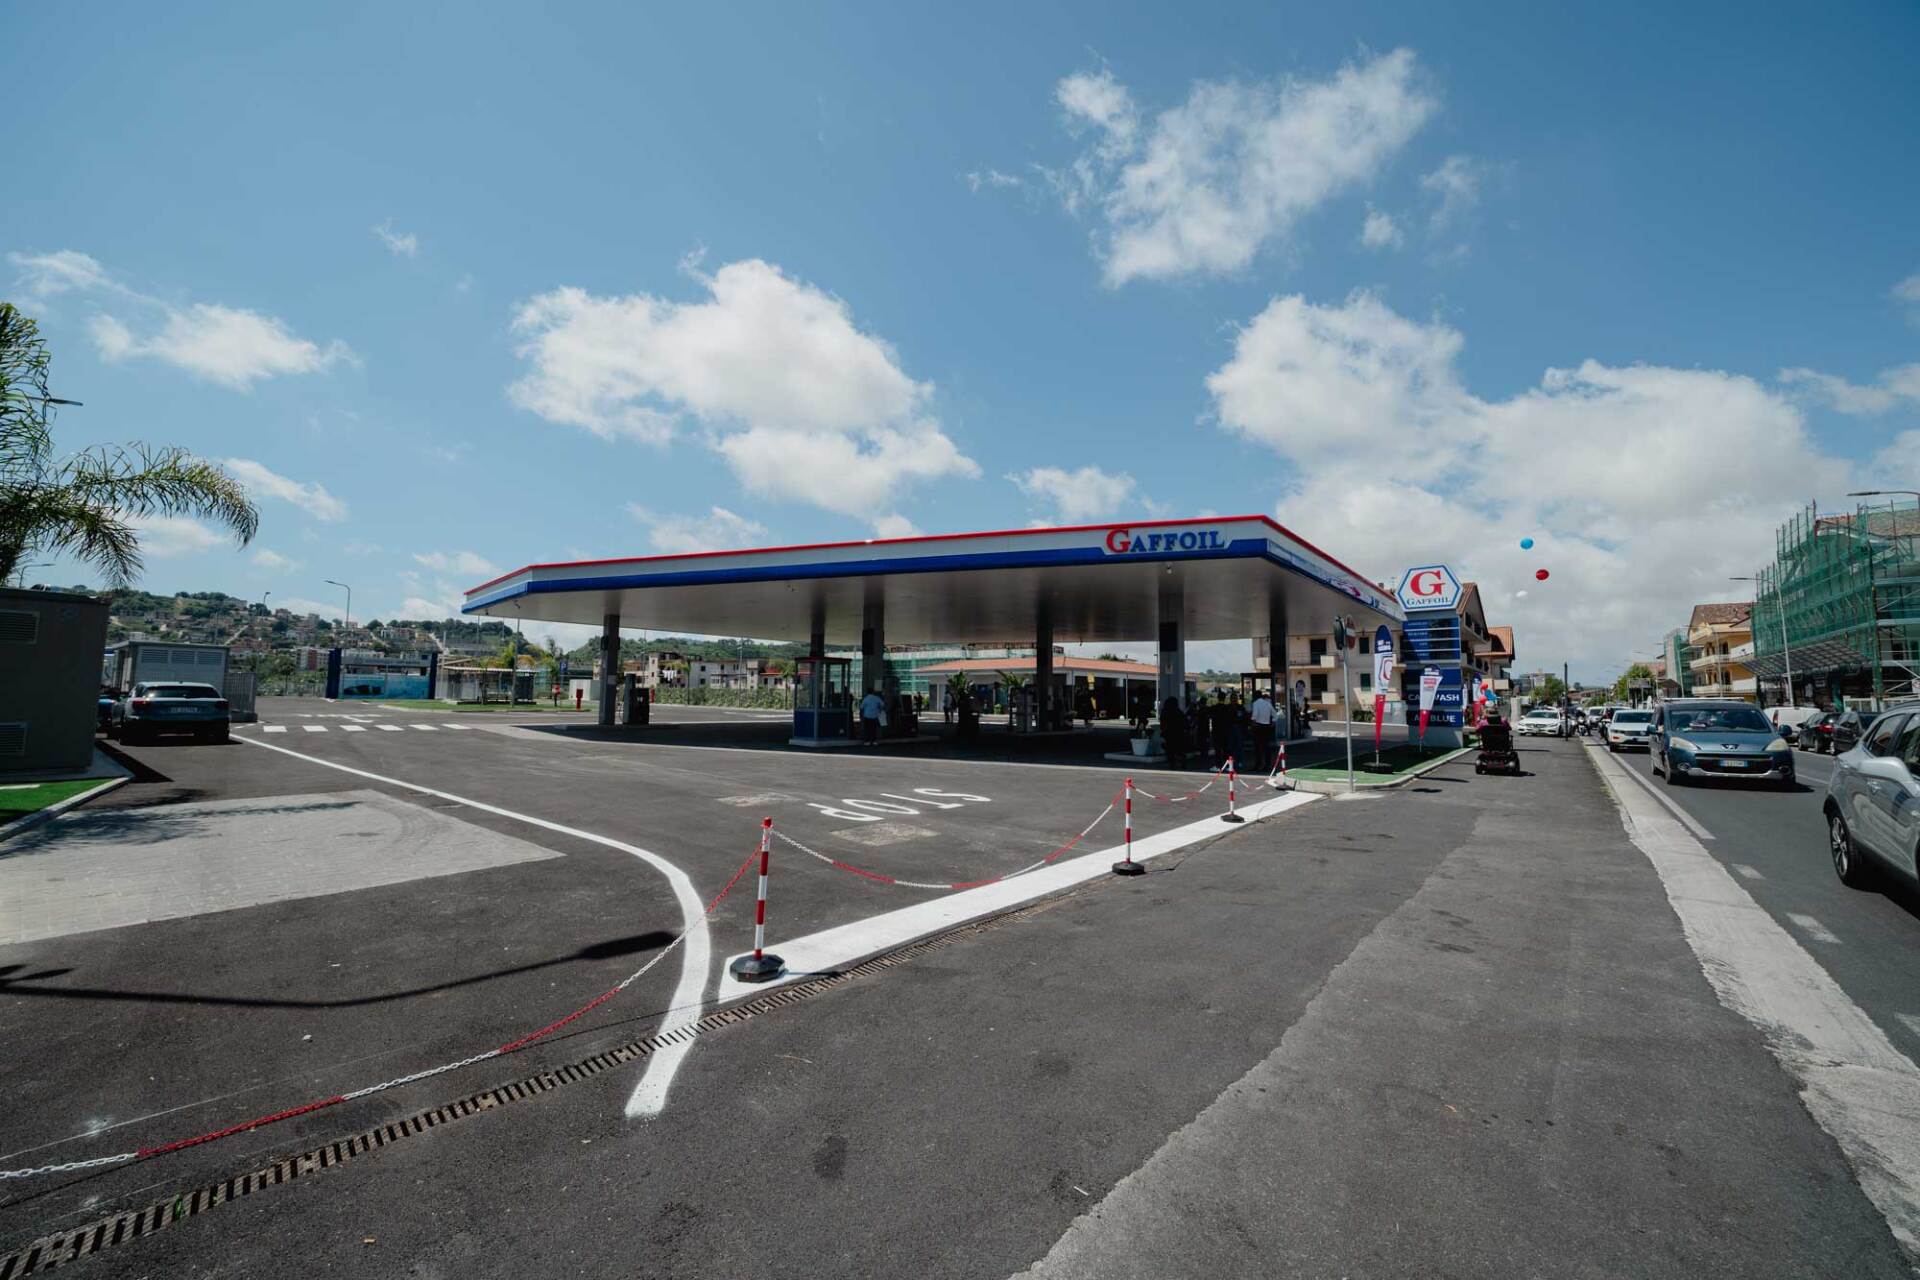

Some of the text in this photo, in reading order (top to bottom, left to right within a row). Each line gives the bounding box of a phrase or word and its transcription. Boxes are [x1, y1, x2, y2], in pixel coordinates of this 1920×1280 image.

[1106, 528, 1225, 553] GAFFOIL
[1410, 570, 1446, 596] G
[1406, 597, 1451, 606] GAFFOIL
[806, 788, 992, 821] STOP
